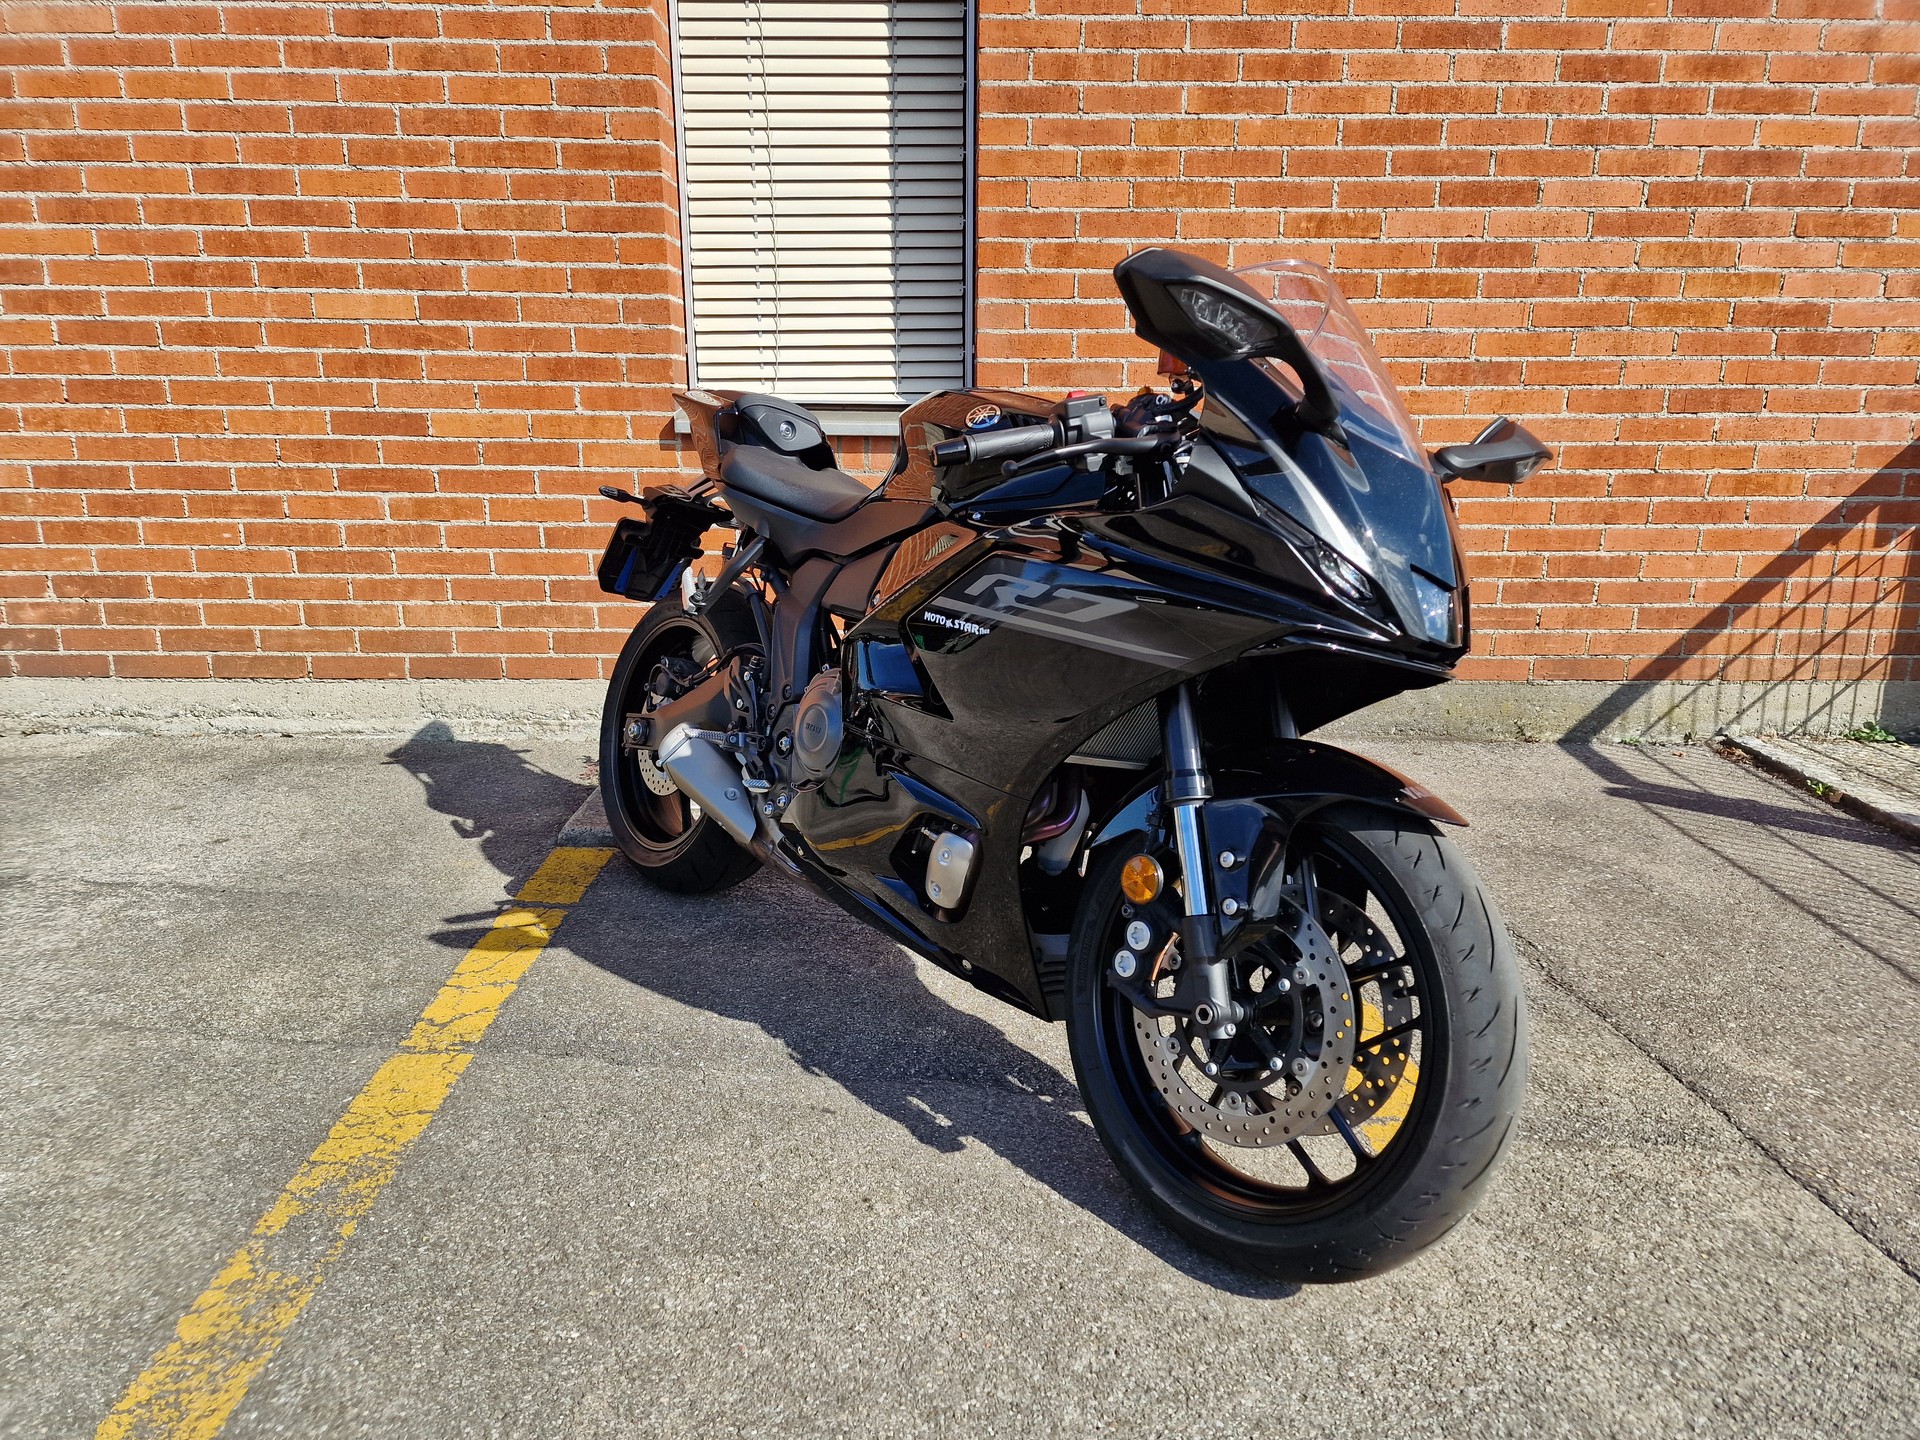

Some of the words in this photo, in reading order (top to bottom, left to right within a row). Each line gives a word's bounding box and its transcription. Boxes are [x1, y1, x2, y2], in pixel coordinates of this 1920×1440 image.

[964, 573, 1139, 622] R7
[923, 611, 946, 625] MOTO
[954, 619, 979, 635] STAR
